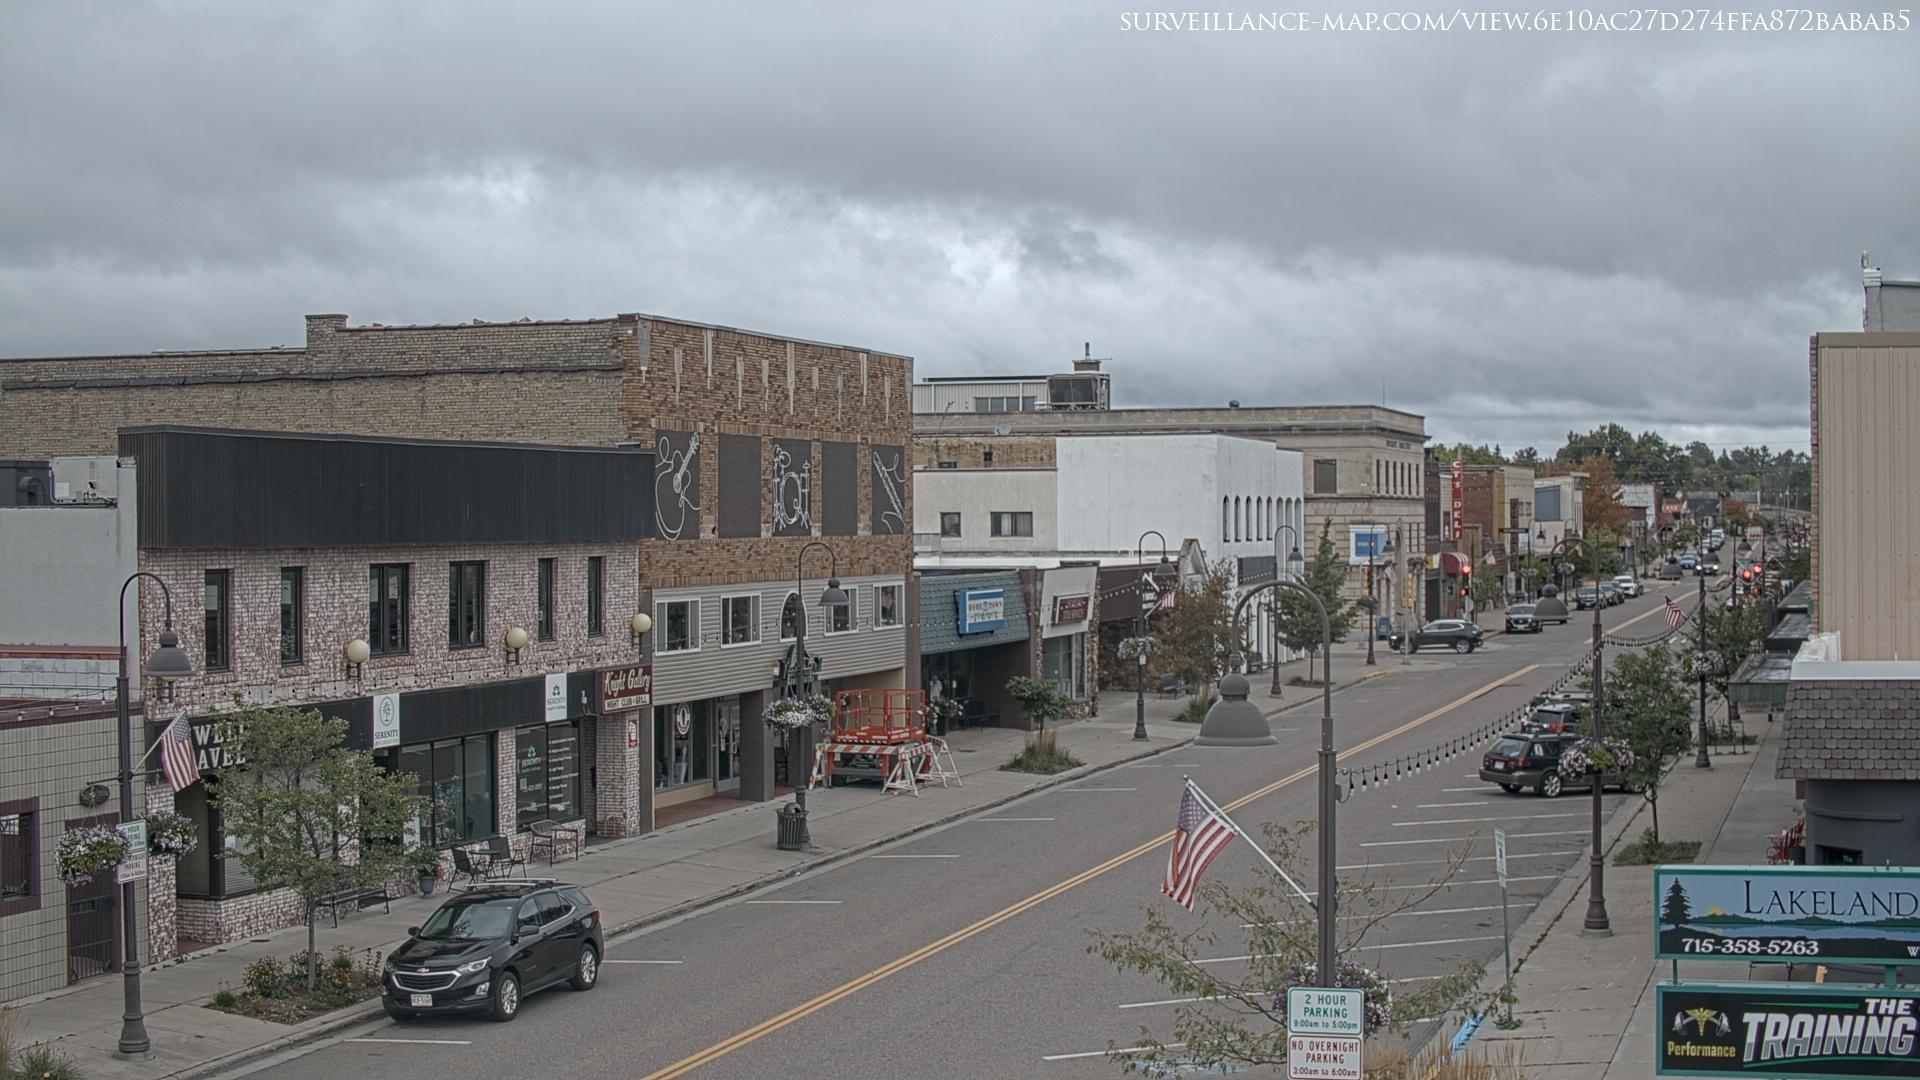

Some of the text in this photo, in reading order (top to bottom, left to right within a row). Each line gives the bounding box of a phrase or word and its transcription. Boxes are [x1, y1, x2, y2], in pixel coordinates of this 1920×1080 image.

[1453, 501, 1462, 538] DELI
[604, 667, 651, 697] Knight Gallery
[621, 697, 633, 707] CLUB
[375, 729, 399, 740] SERENITY
[1744, 880, 1919, 917] LAKELAND
[1682, 938, 1819, 955] 715-358-5263
[1305, 994, 1346, 1006] 2 HOUR
[1864, 998, 1914, 1015] THE
[1304, 1007, 1348, 1019] PARKING
[1294, 1019, 1358, 1030] 9:00am to 5:00pm
[1742, 1012, 1917, 1062] TRAINING
[1292, 1041, 1359, 1053] NO OVERNIGHT
[1668, 1041, 1736, 1058] Performance
[1306, 1053, 1345, 1065] PARKING
